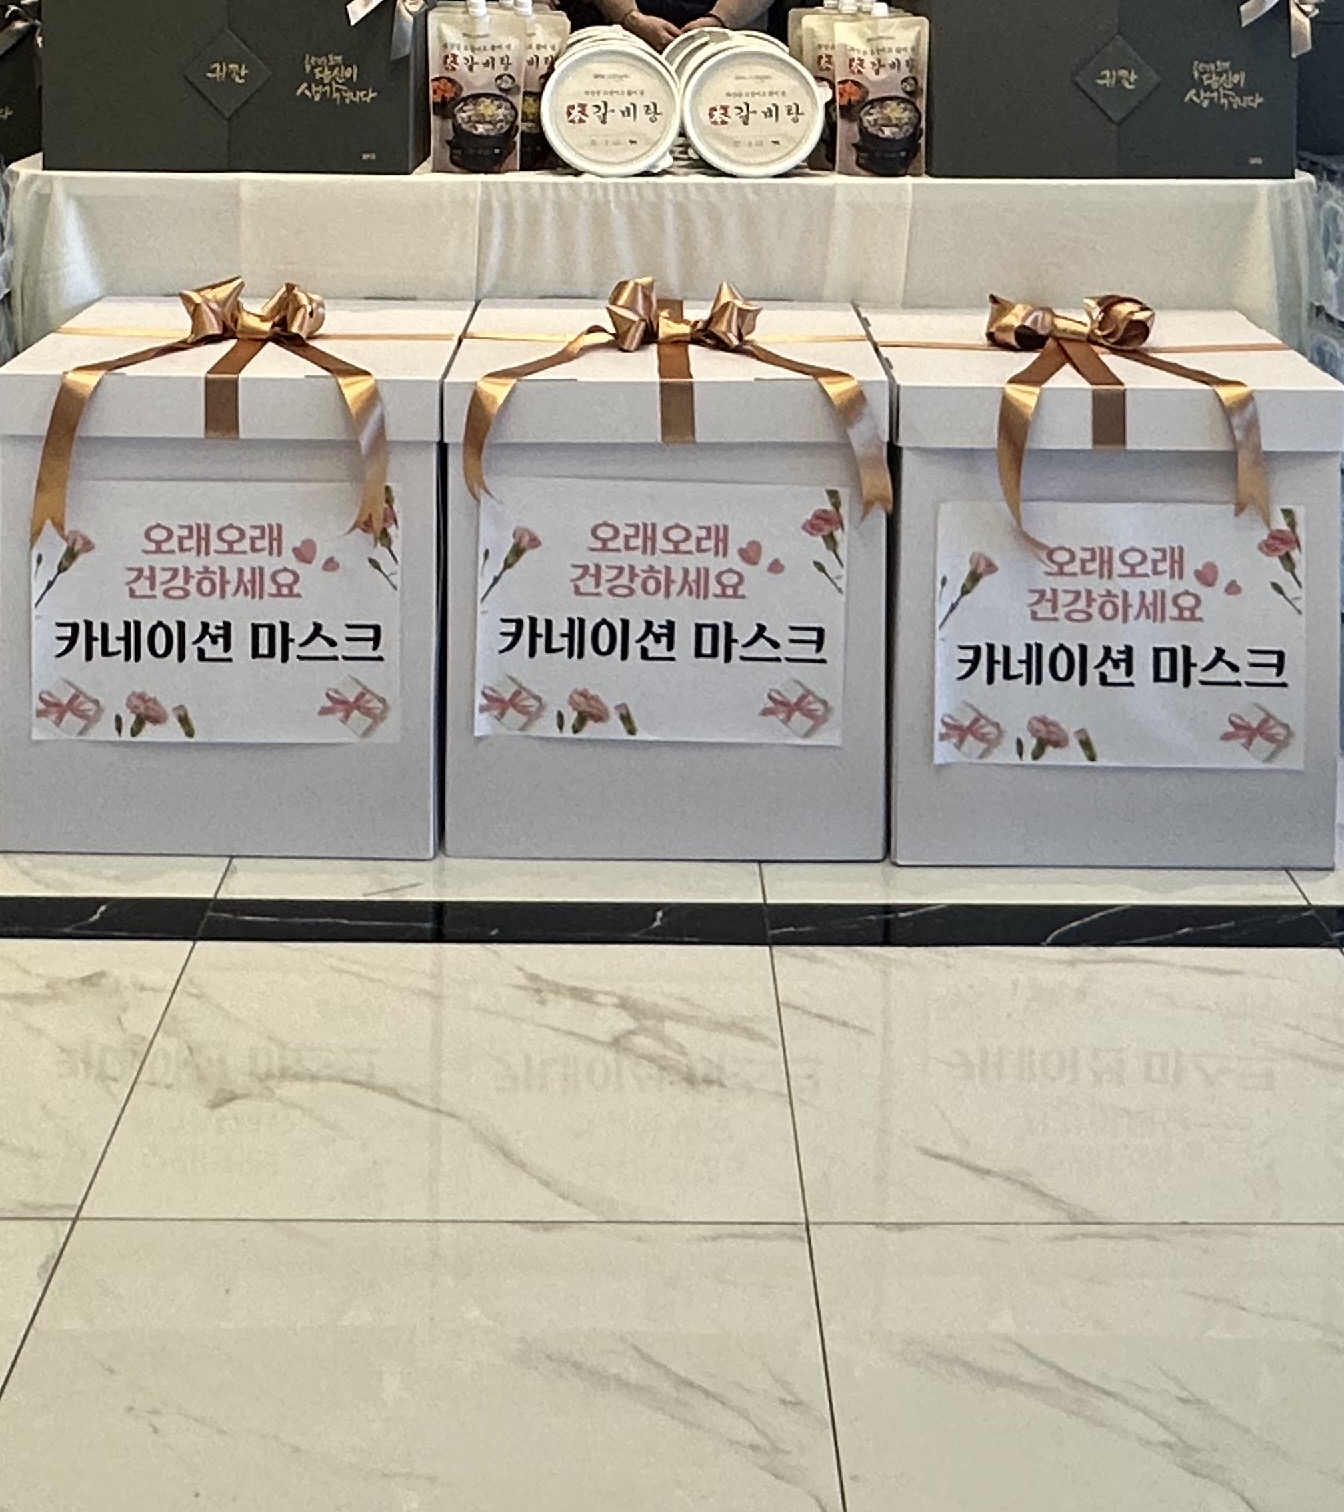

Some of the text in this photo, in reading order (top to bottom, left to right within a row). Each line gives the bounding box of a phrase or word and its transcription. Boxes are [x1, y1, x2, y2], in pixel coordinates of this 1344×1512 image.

[142, 521, 284, 558] 오래오래
[587, 520, 730, 559] 오래오래
[569, 562, 747, 601] 건강하세요
[1043, 543, 1186, 582] 오래오래
[125, 564, 303, 601] 건강하세요
[1026, 587, 1205, 625] 건강하세요
[54, 617, 385, 665] 카네이션 마스크
[497, 614, 828, 665] 카네이션 마스크
[955, 641, 1289, 689] 카네이션 마스크
